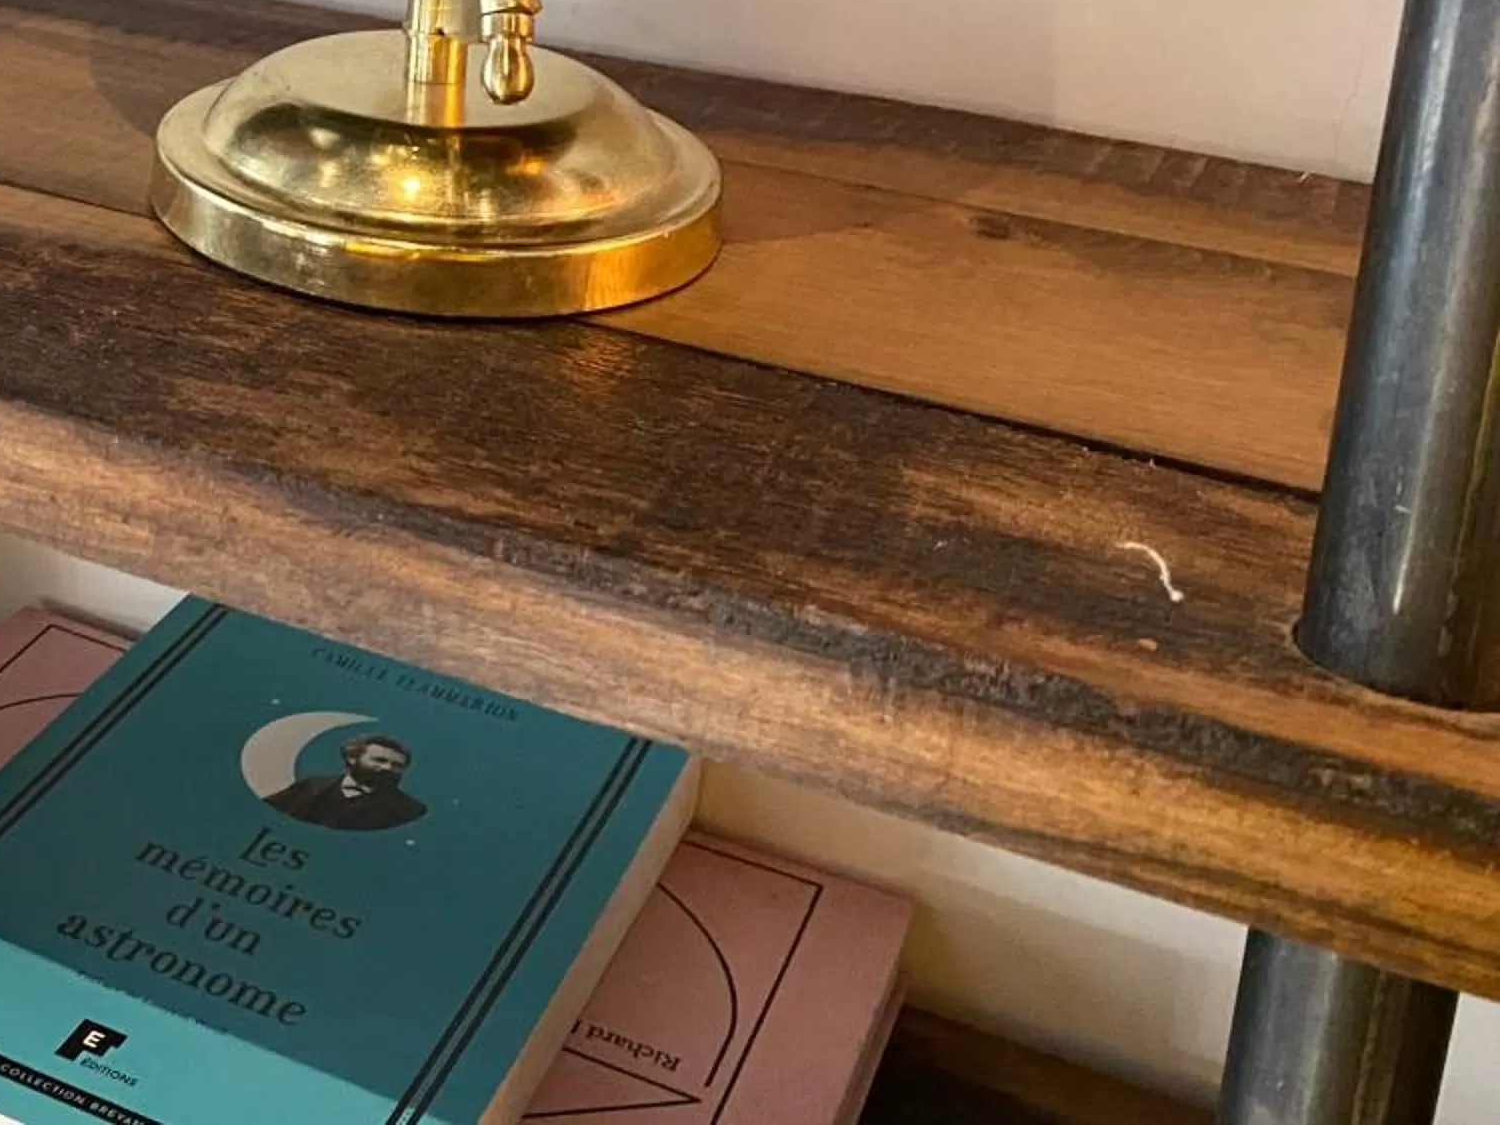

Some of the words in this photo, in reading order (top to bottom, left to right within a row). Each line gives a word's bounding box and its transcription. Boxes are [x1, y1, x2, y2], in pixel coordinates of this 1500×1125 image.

[311, 646, 390, 682] CAMILLE
[395, 674, 520, 722] FLAMMARION
[238, 825, 311, 872] Les
[135, 839, 362, 941] mémoires
[164, 896, 262, 957] d'un
[55, 912, 309, 1028] astronome
[585, 1023, 682, 1073] Richard
[0, 1062, 86, 1106] COLLECTION
